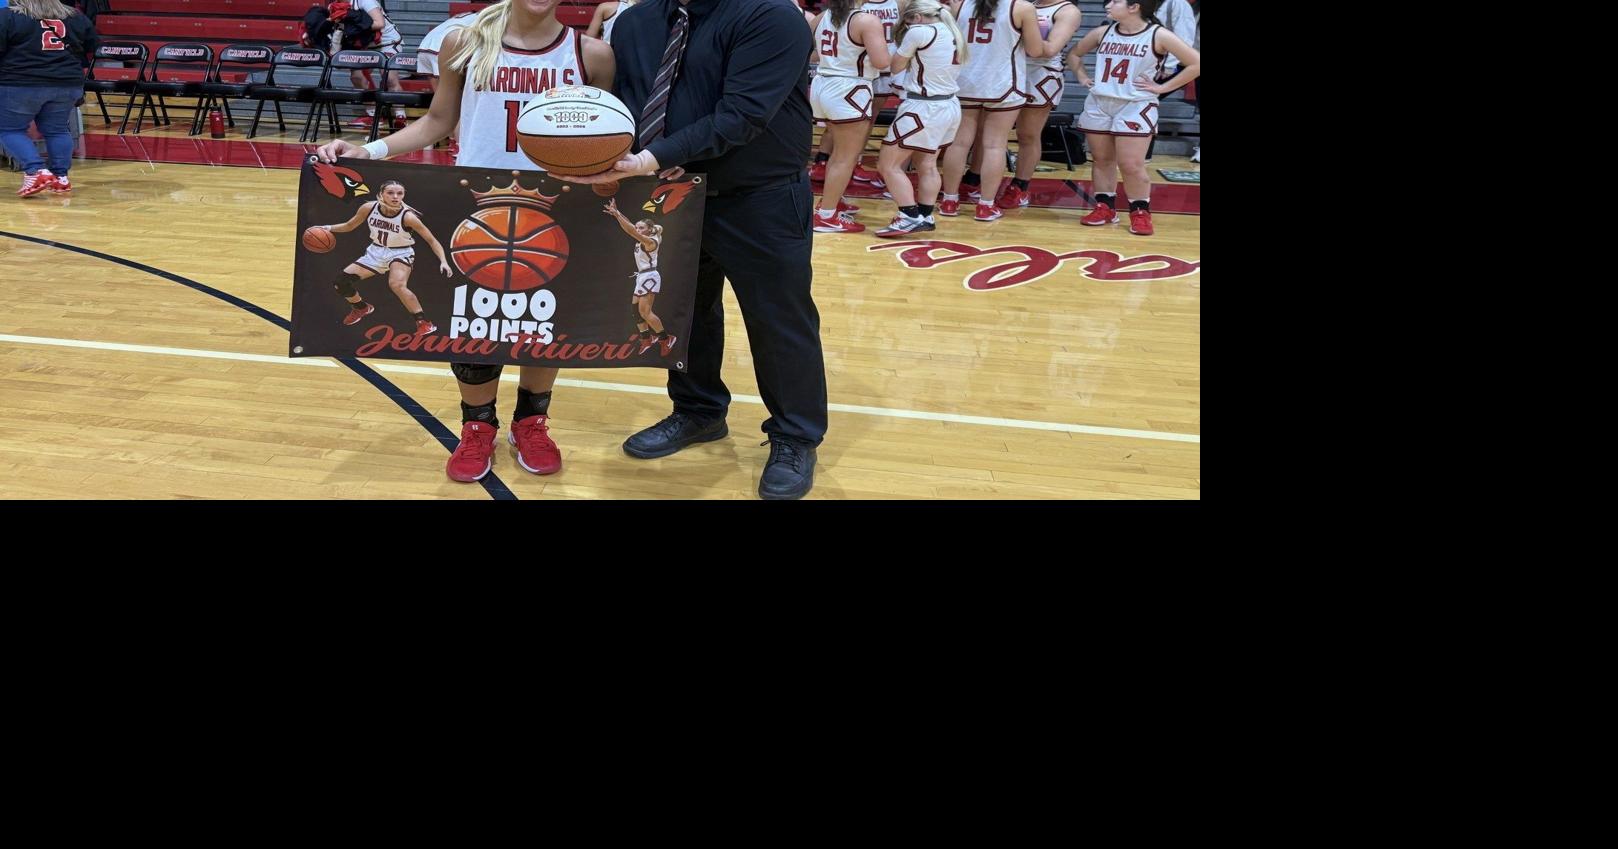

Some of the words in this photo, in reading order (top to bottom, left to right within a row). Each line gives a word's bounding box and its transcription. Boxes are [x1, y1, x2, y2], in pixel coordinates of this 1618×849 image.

[40, 18, 66, 51] 2
[967, 18, 996, 44] 15
[101, 46, 140, 55] CANFIELD
[821, 29, 838, 57] 21
[1098, 41, 1148, 57] CARDINALS
[164, 47, 204, 57] CANFIELD
[227, 49, 267, 58] CANFIELD
[281, 53, 320, 61] CANFIELD
[338, 55, 379, 64] CANFIELD
[1101, 58, 1130, 84] 14
[554, 111, 589, 123] 1000
[504, 100, 529, 152] 1
[369, 217, 400, 234] CARDINALS
[377, 230, 389, 246] 11
[452, 284, 557, 322] 1000
[449, 316, 555, 346] POINTS
[355, 323, 500, 357] Jenna
[505, 332, 639, 360] Triveri
